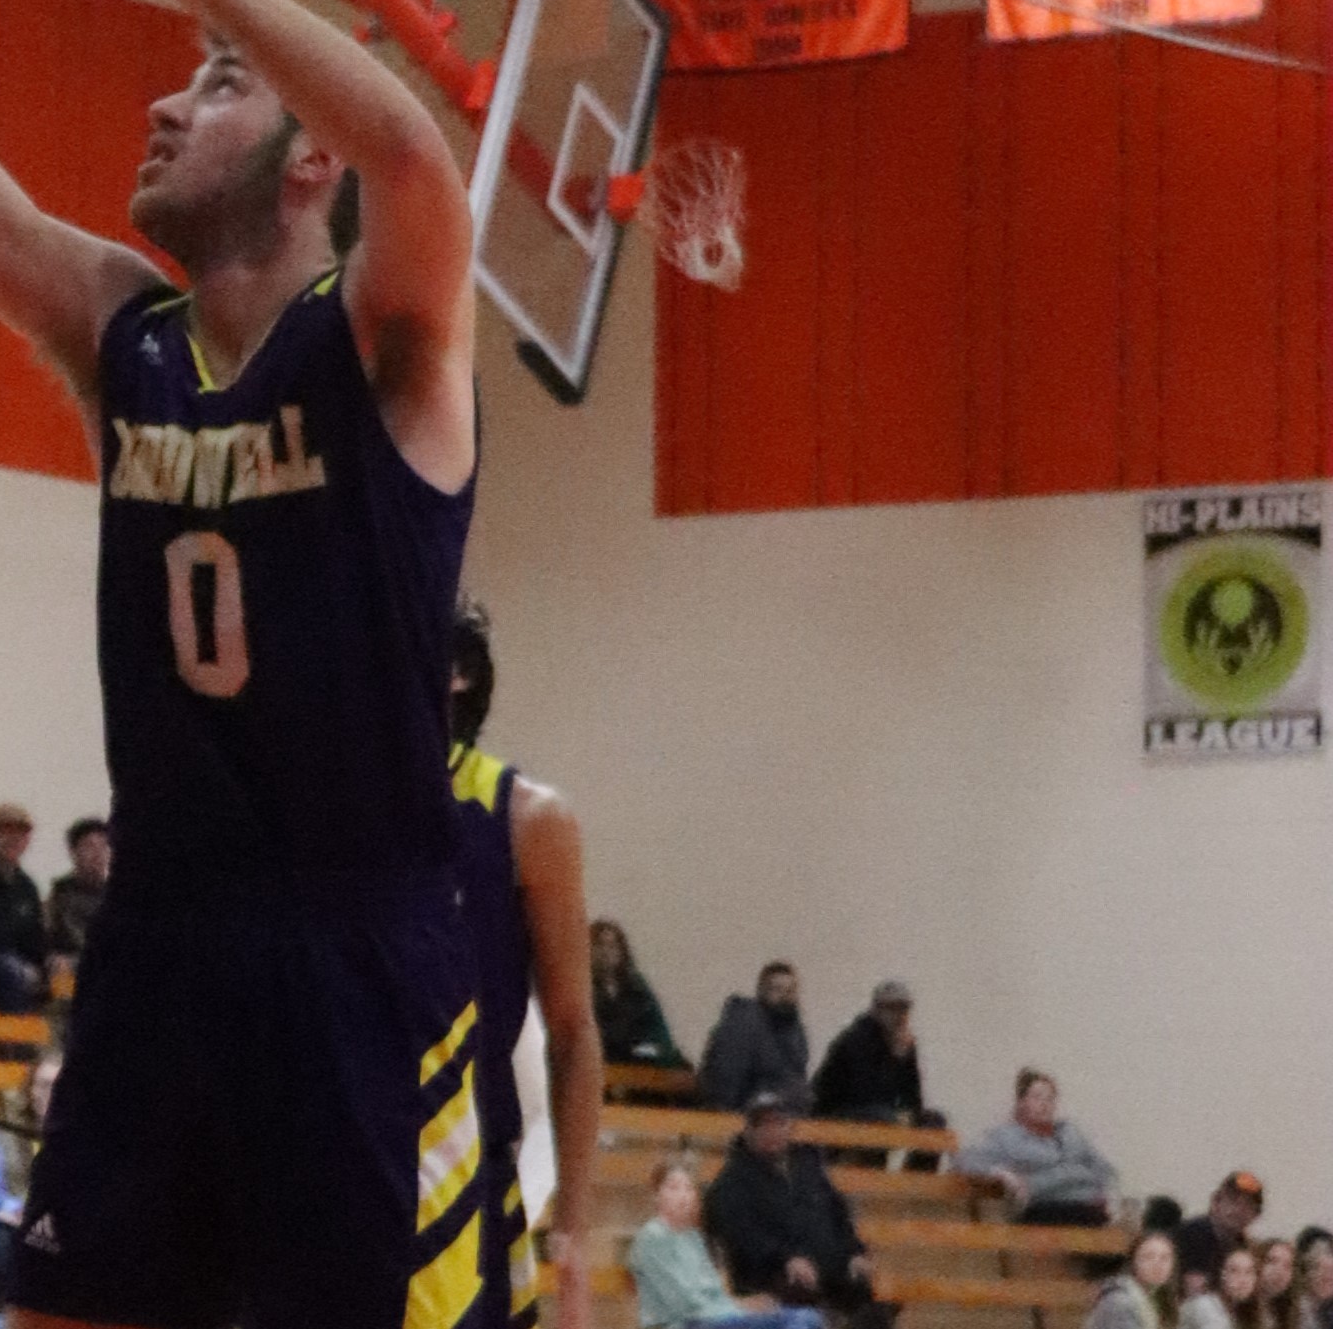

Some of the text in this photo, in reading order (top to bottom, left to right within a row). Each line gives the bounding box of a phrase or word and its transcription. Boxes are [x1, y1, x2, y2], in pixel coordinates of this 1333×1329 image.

[1145, 490, 1322, 533] HI-PLAINS
[164, 530, 251, 700] 0
[1148, 715, 1320, 754] LEAGUE
